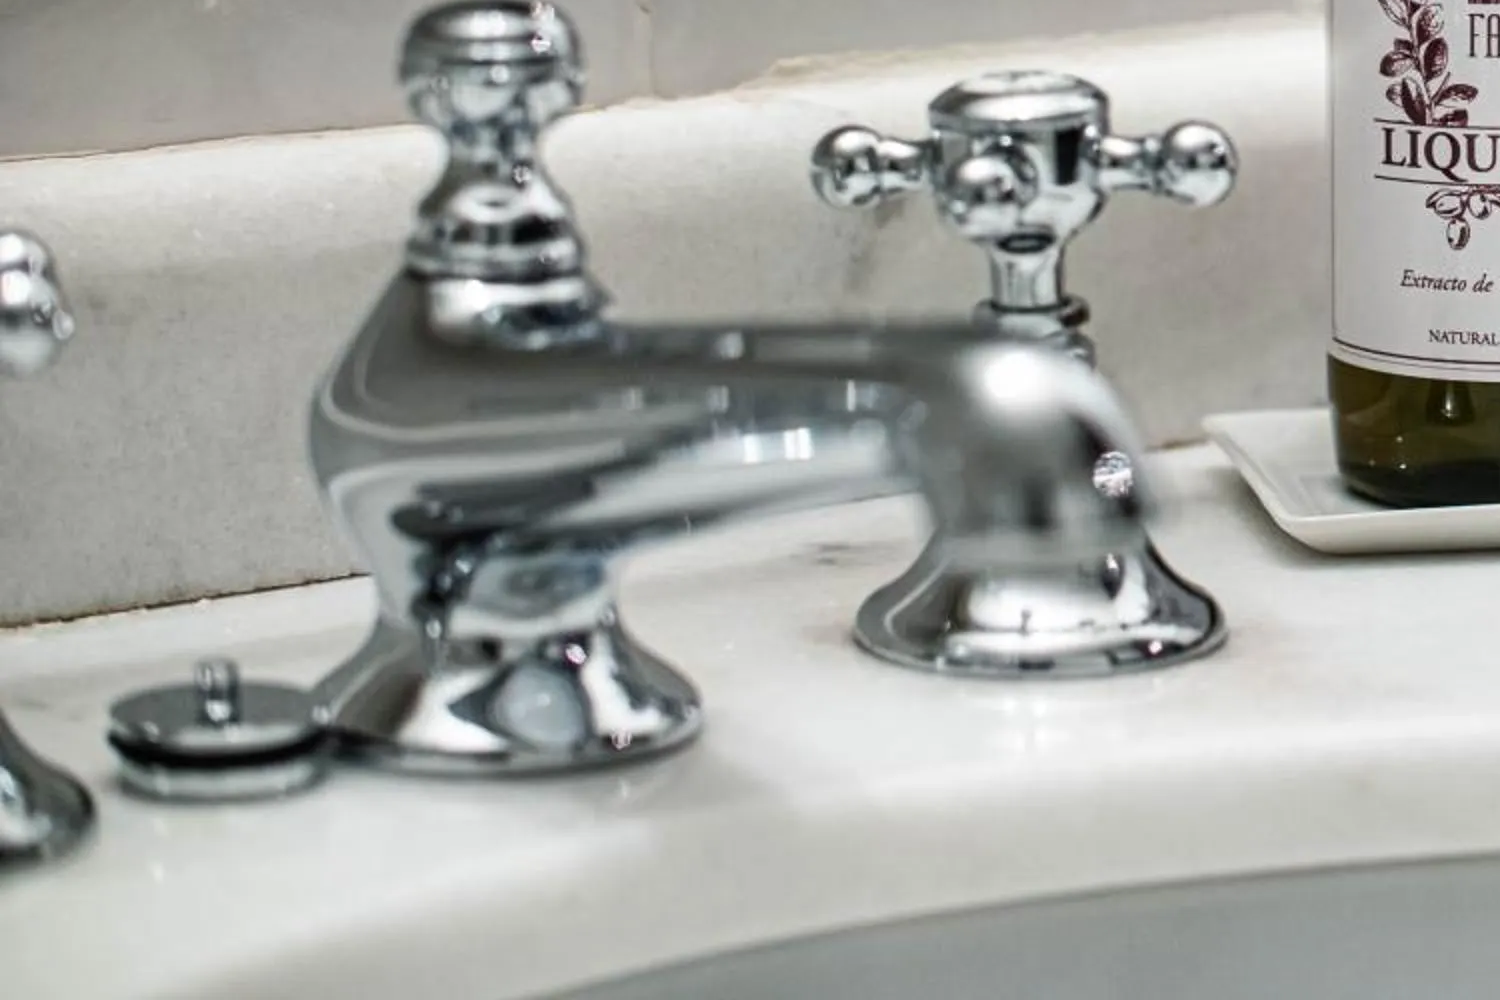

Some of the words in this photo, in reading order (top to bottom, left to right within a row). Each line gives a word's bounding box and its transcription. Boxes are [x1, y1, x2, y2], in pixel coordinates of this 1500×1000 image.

[1400, 269, 1467, 292] Extracto
[1472, 273, 1494, 293] de
[1428, 328, 1500, 346] NATURAL
